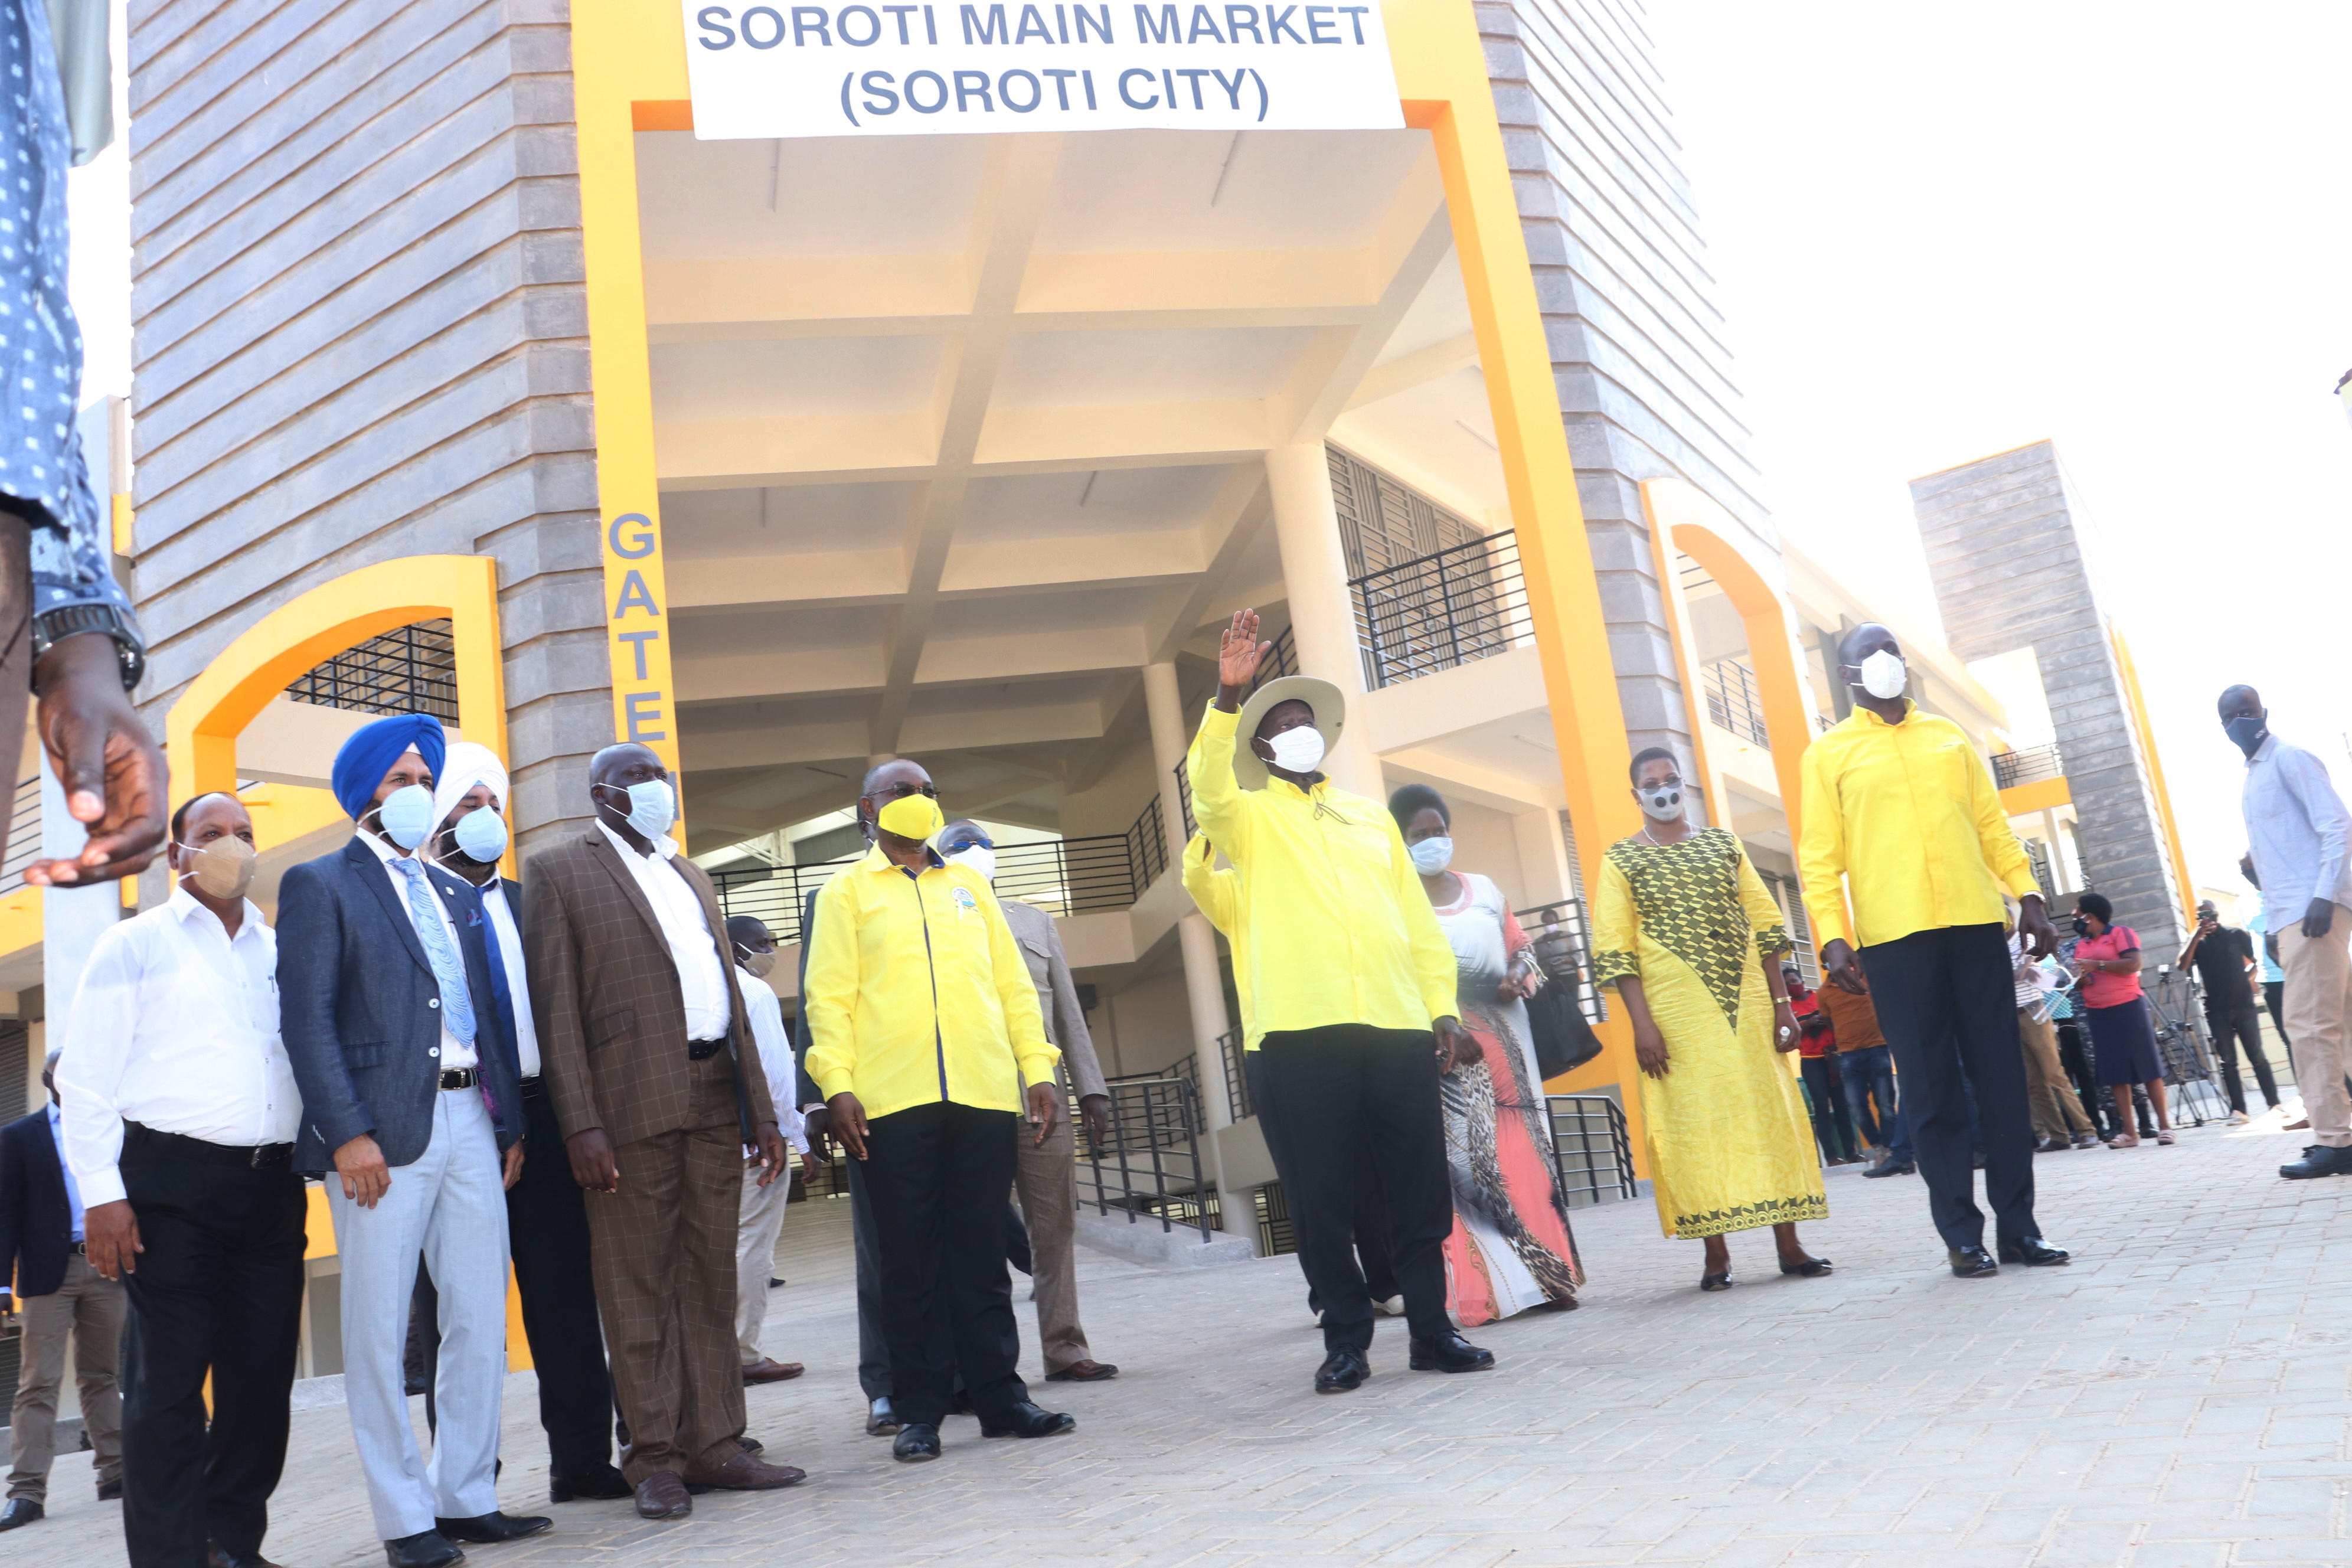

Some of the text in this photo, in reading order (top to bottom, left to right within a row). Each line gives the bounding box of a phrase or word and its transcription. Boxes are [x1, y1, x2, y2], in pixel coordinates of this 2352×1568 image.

[697, 4, 1369, 50] SOROTI MAIN MARKET
[841, 68, 1269, 127] (SOROTI CITY)
[609, 512, 665, 741] GATE
